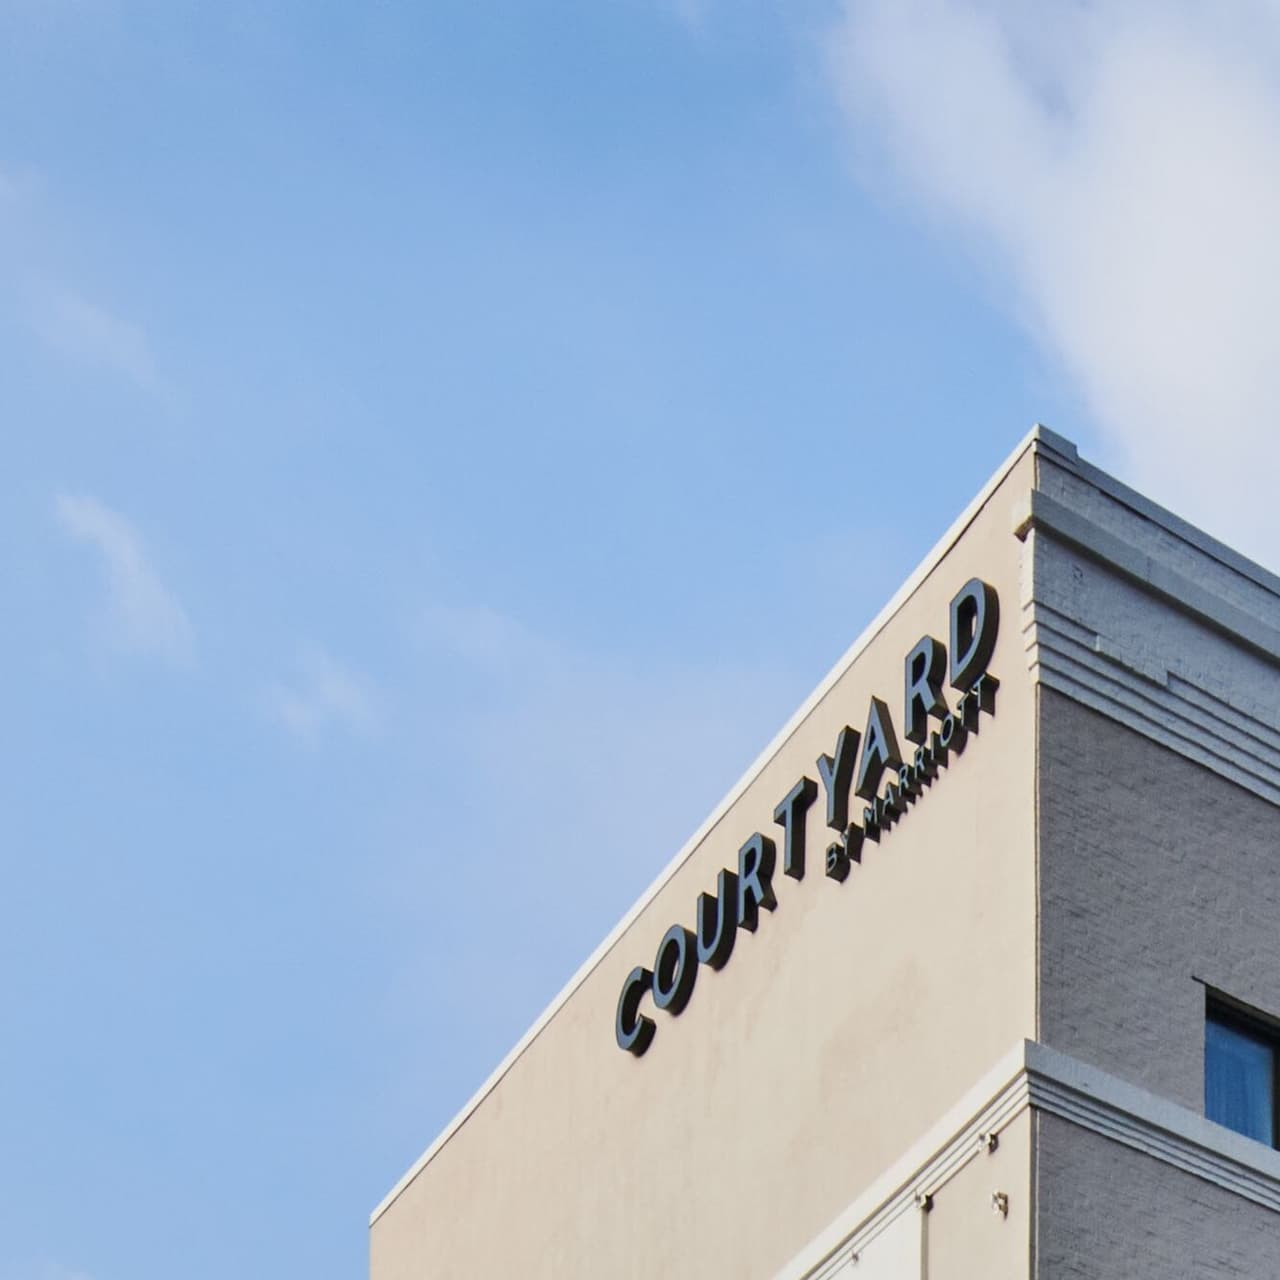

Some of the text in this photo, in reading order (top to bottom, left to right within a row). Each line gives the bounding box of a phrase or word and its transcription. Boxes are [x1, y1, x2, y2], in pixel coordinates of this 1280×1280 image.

[615, 577, 1000, 1057] COURTYARD
[825, 672, 1000, 883] BY MARRIOTT
